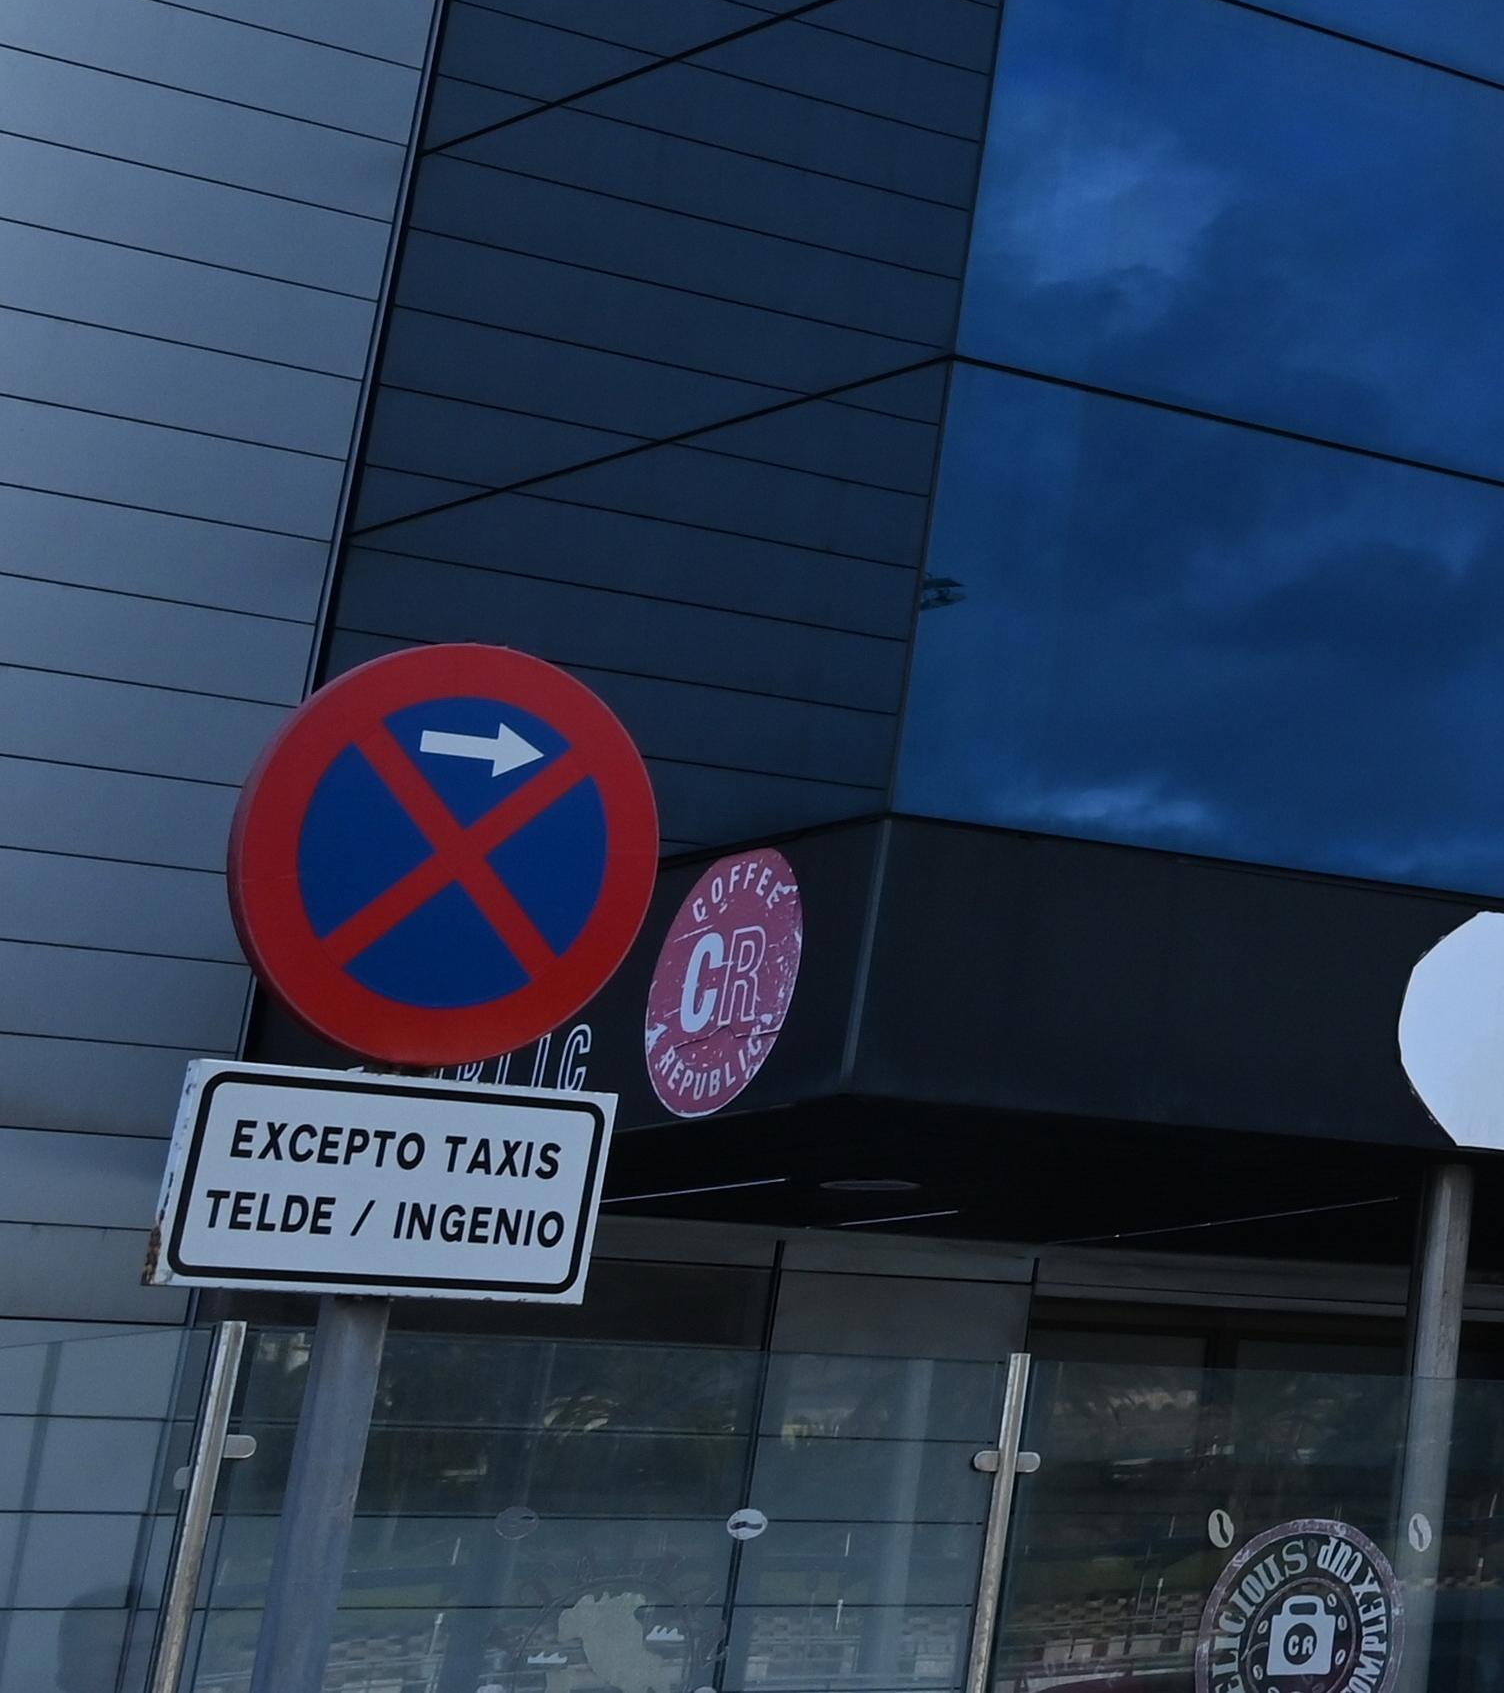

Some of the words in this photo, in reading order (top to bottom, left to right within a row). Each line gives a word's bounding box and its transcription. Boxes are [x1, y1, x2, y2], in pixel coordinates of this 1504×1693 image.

[692, 861, 784, 923] COFFEE
[680, 925, 766, 1033] CR
[656, 1025, 765, 1100] REPUBLIC
[229, 1119, 425, 1171] EXCEPTO
[444, 1135, 561, 1180] TAXIS
[205, 1190, 336, 1236] TELDE
[350, 1199, 375, 1237] /
[393, 1202, 565, 1249] INGENIO
[1316, 1535, 1363, 1584] CUP
[1287, 1634, 1315, 1657] CR
